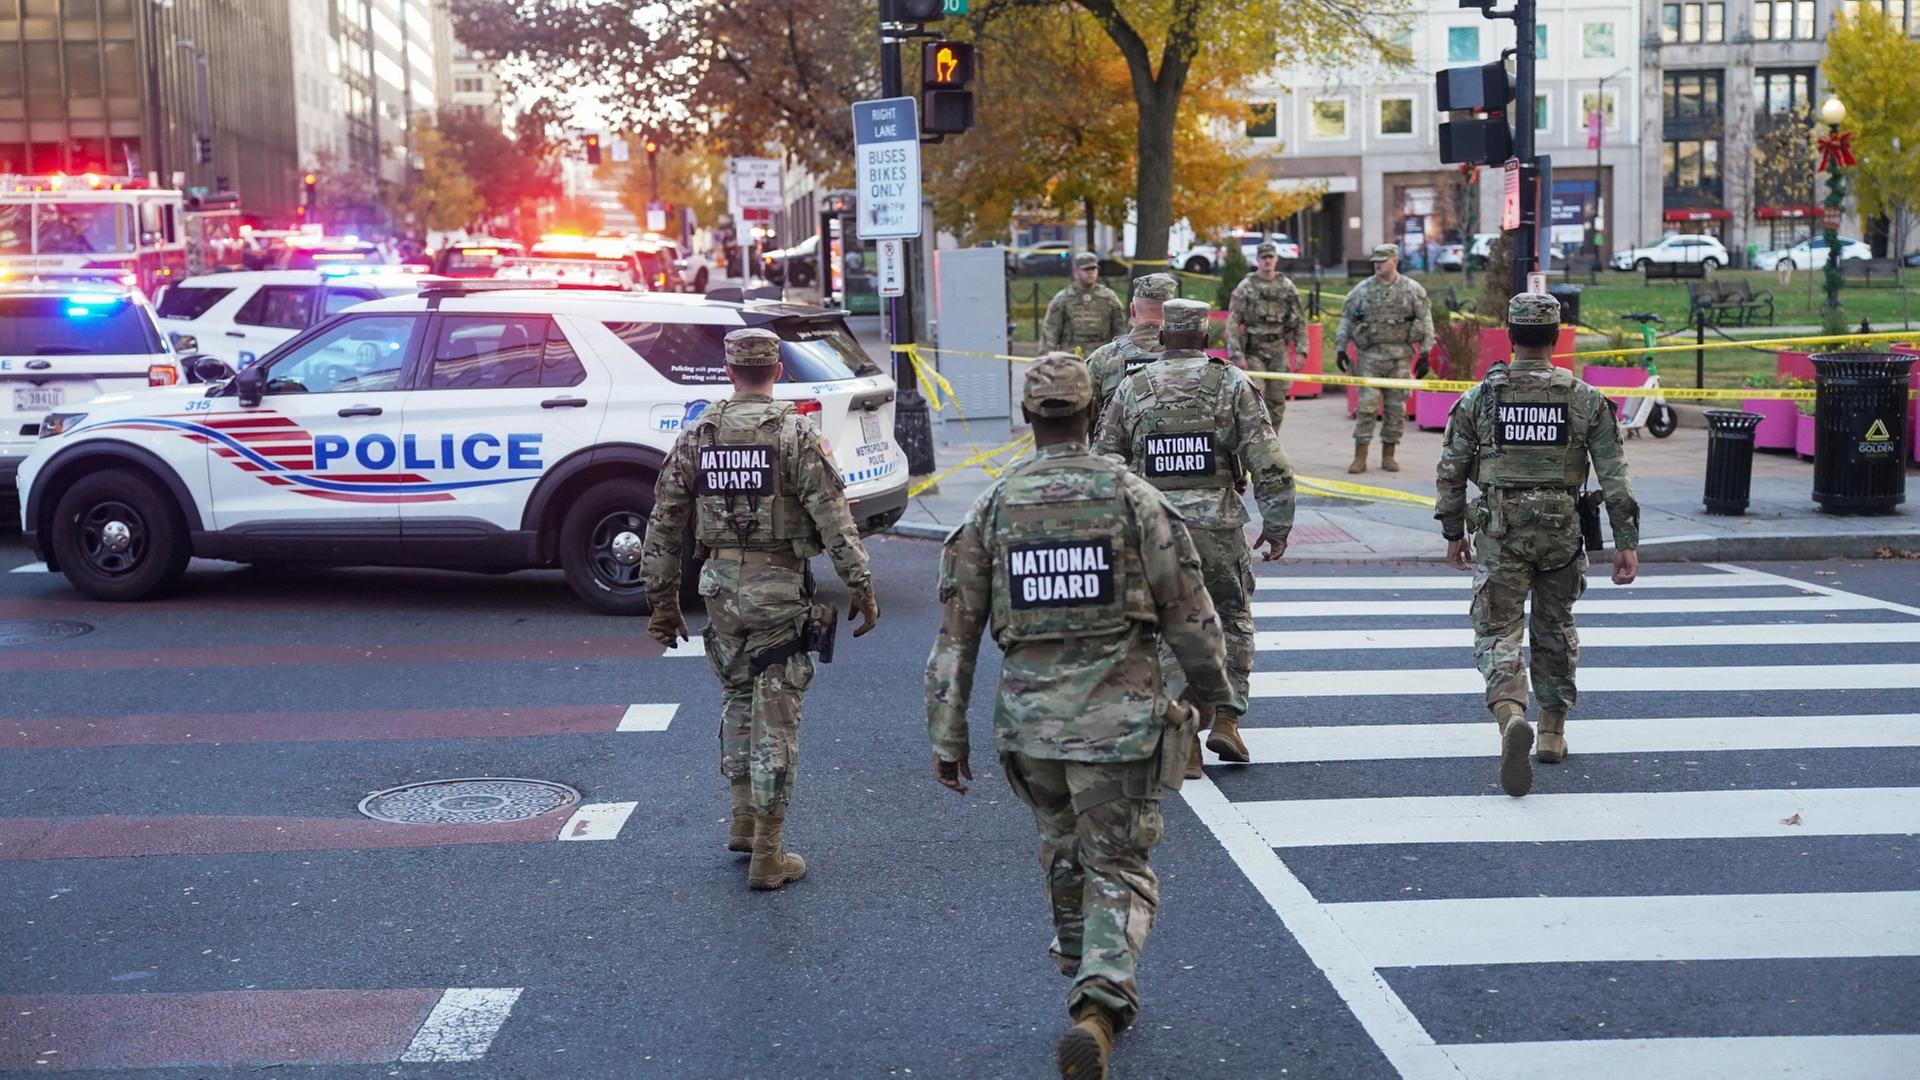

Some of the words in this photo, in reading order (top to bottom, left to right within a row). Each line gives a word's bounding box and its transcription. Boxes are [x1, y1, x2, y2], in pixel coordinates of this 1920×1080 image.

[871, 107, 897, 121] RIGHT
[874, 124, 898, 138] LANE
[868, 148, 906, 165] BUSES
[869, 166, 907, 182] BIKES
[871, 182, 905, 198] ONLY
[671, 365, 695, 373] Policing
[185, 400, 212, 411] 315
[1498, 406, 1566, 423] NATIONAL
[1504, 424, 1558, 441] GUARD
[314, 433, 544, 470] POLICE
[1147, 436, 1212, 455] NATIONAL
[1858, 444, 1894, 453] GOLDEN
[701, 450, 770, 470] NATIONAL
[869, 453, 886, 465] POLICE
[1155, 454, 1206, 472] GUARD
[706, 471, 763, 490] GUARD
[1011, 546, 1110, 576] NATIONAL
[1022, 573, 1101, 602] GUARD
